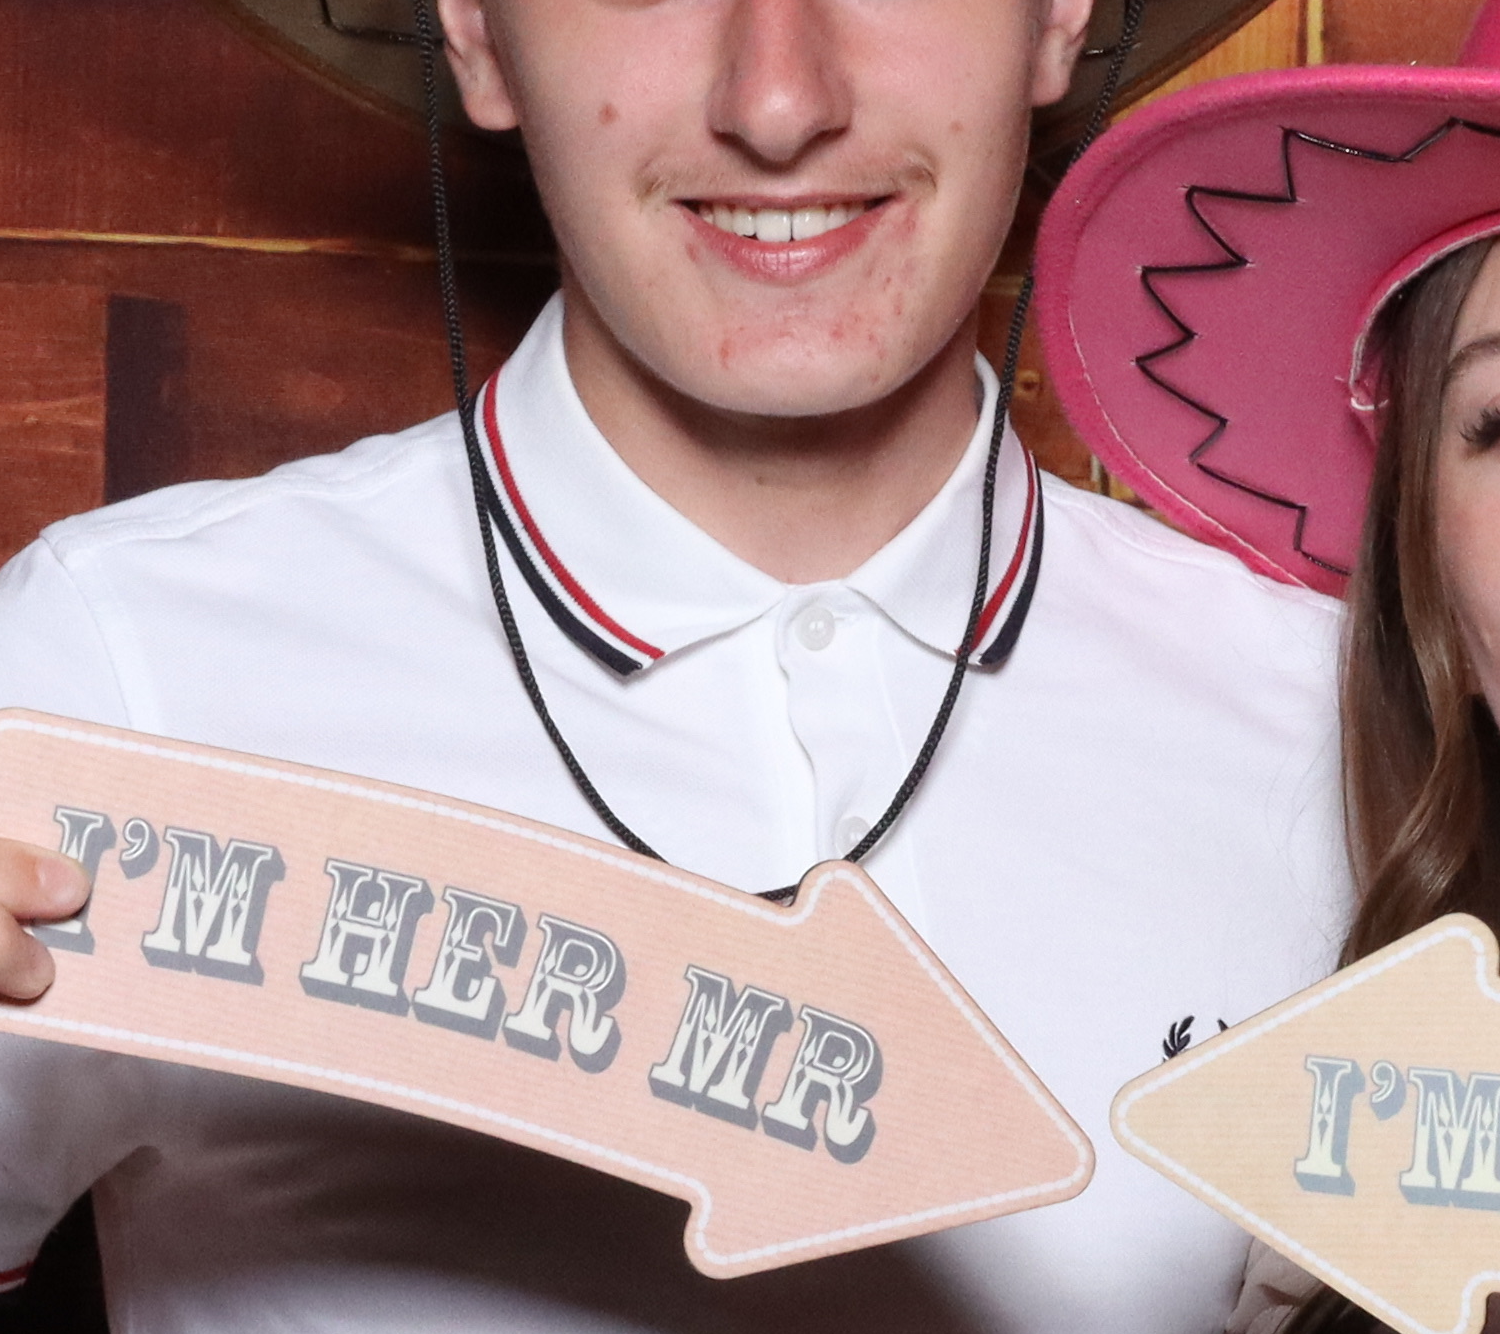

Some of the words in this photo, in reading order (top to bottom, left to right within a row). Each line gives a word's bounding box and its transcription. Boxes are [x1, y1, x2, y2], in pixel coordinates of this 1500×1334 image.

[25, 804, 287, 987] I'M
[299, 857, 626, 1073] HER
[648, 963, 883, 1163] MR
